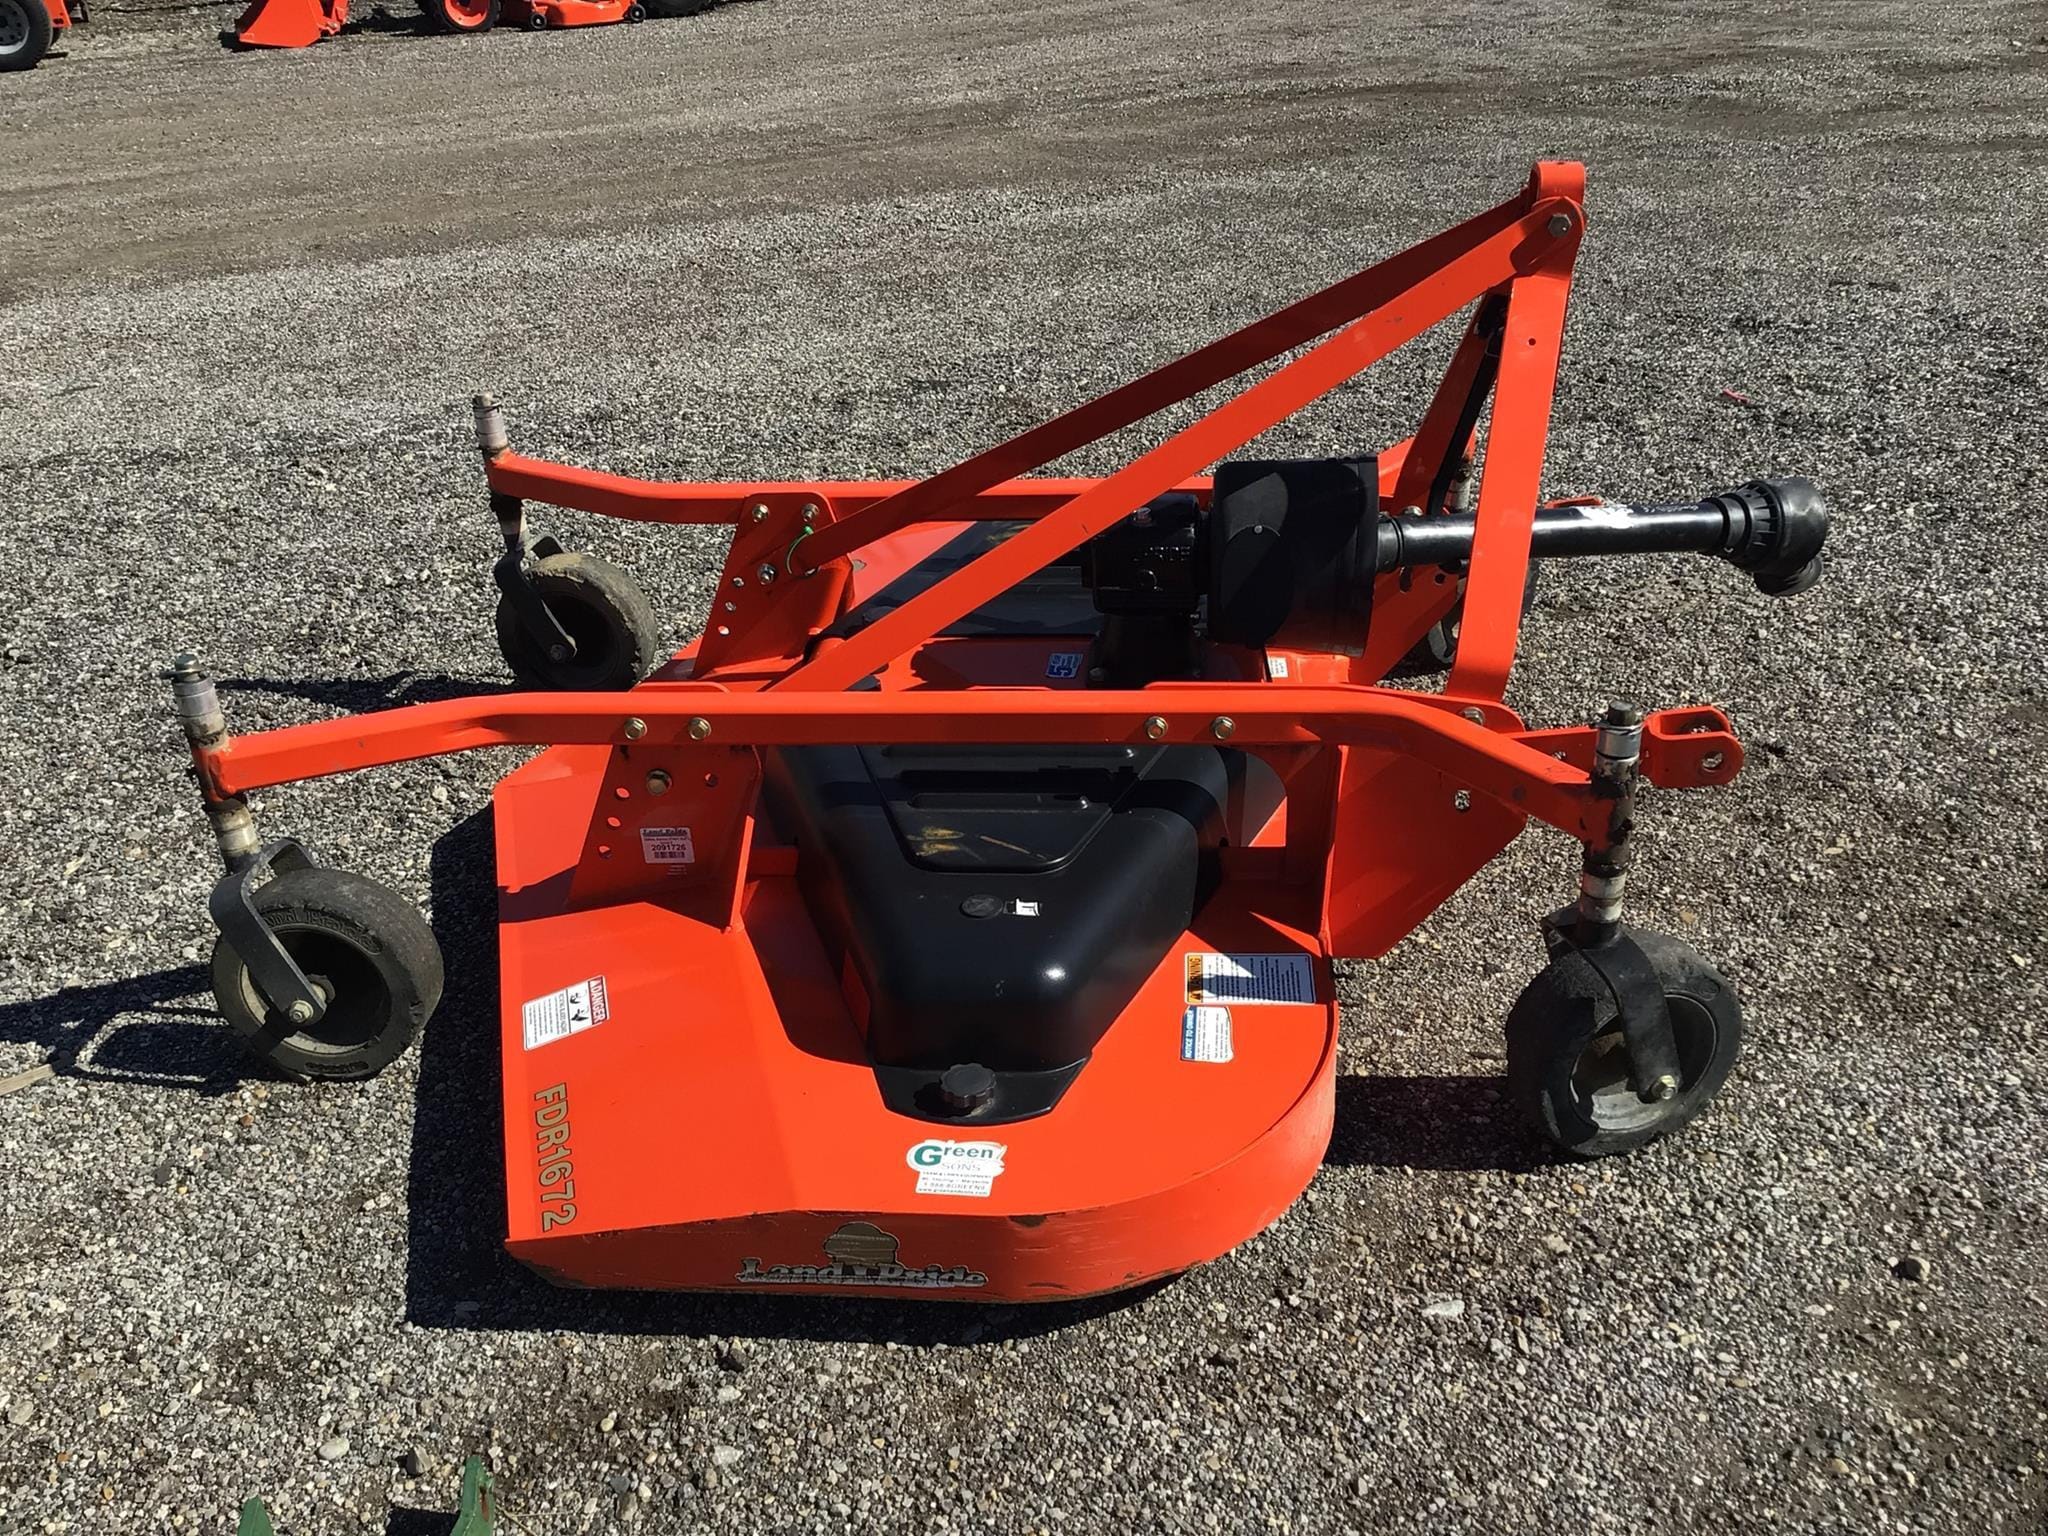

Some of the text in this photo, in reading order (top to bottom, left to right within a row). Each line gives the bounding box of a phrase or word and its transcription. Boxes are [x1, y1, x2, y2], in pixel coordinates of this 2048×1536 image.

[590, 983, 605, 1024] DANGER
[534, 1082, 577, 1232] FDR1672
[914, 1145, 994, 1167] Green
[735, 1257, 988, 1288] Land Pride
